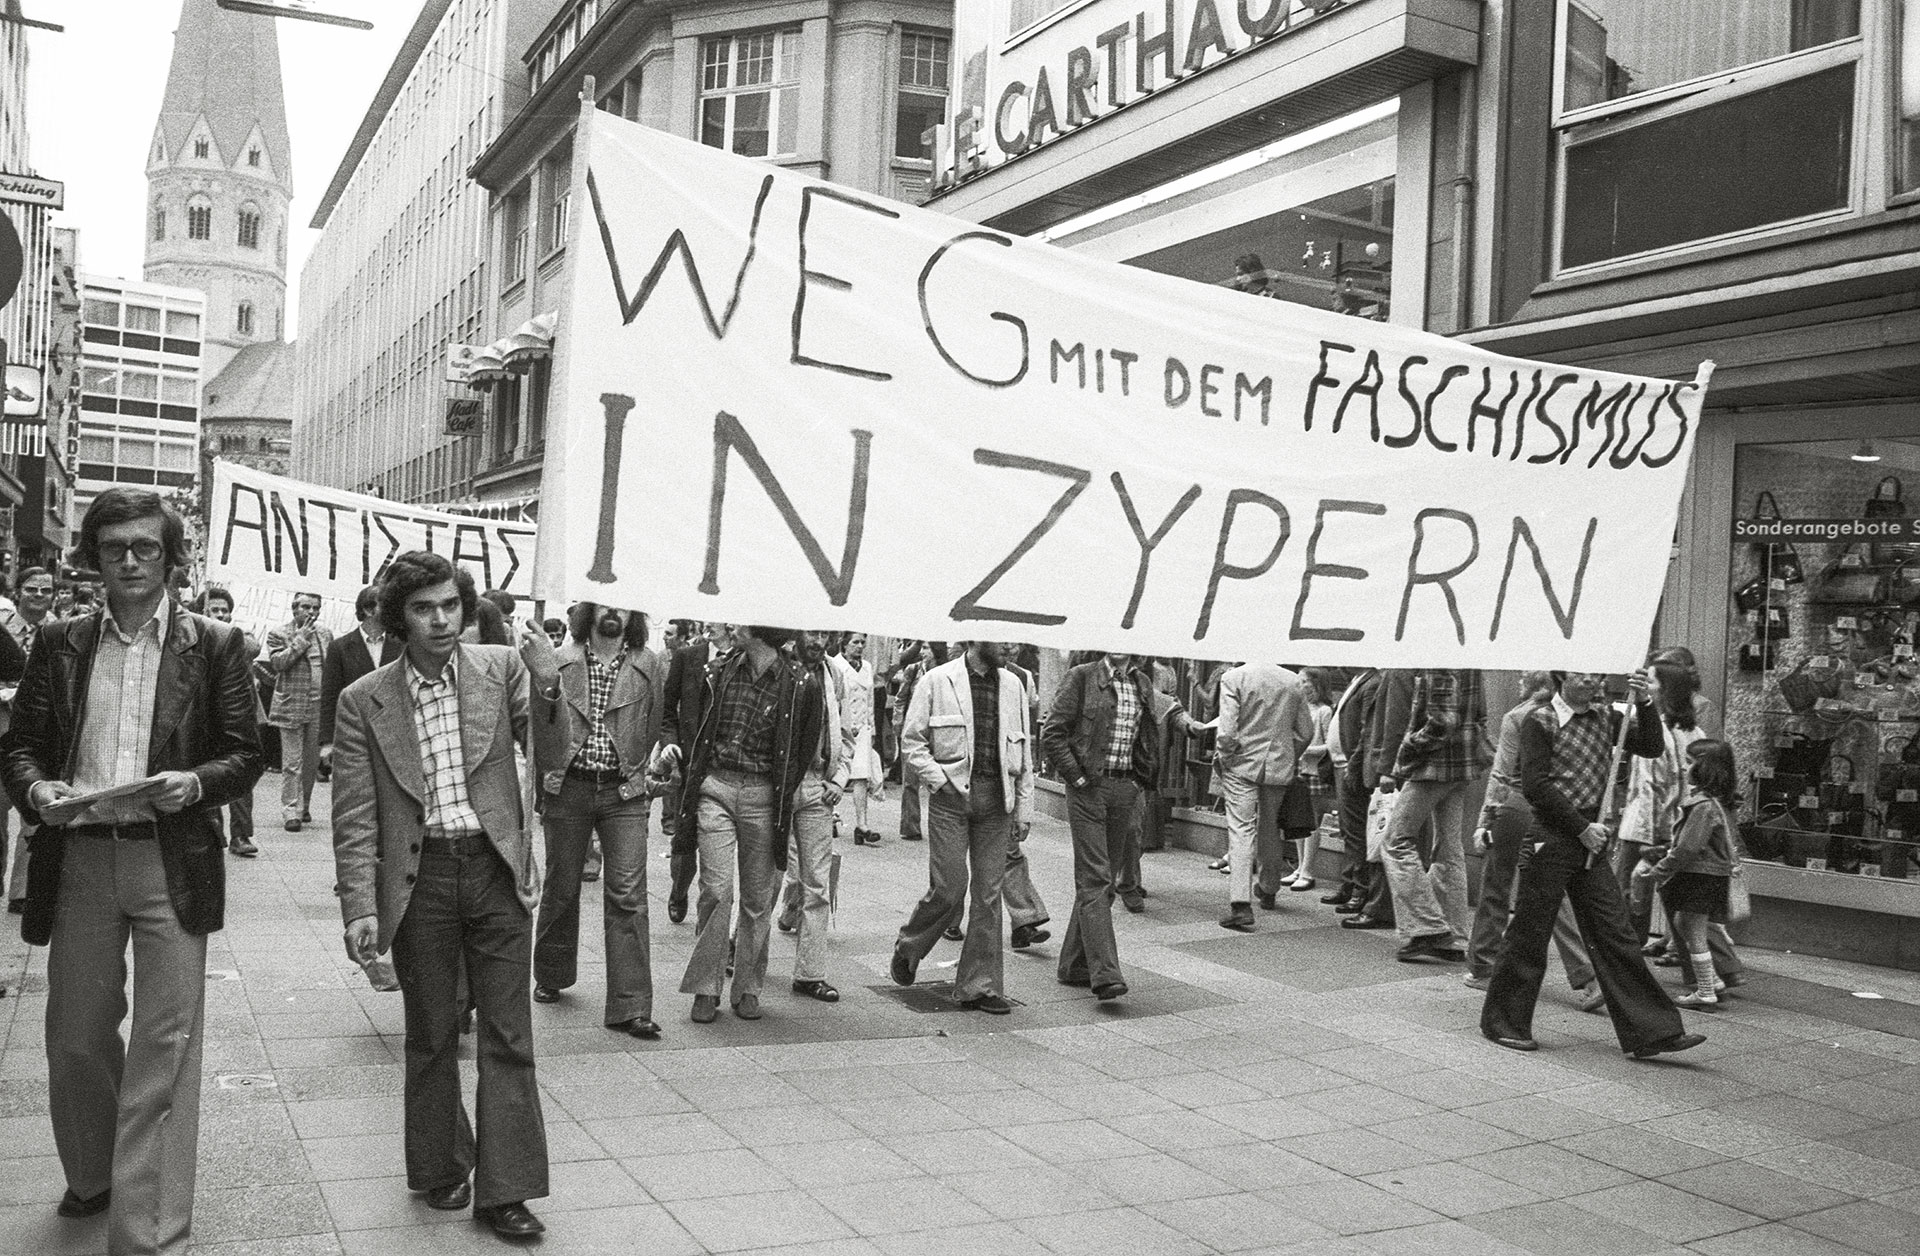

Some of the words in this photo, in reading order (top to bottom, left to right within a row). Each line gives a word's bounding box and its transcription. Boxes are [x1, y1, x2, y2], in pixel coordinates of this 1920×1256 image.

[587, 164, 1030, 389] WEG
[1051, 337, 1138, 396] MIT
[1164, 356, 1273, 426] DEM
[1304, 340, 1699, 470] FASCHISMUS
[586, 392, 873, 606] IN
[949, 447, 1598, 646] ZYPERN
[1735, 519, 1902, 539] Sonderangebote
